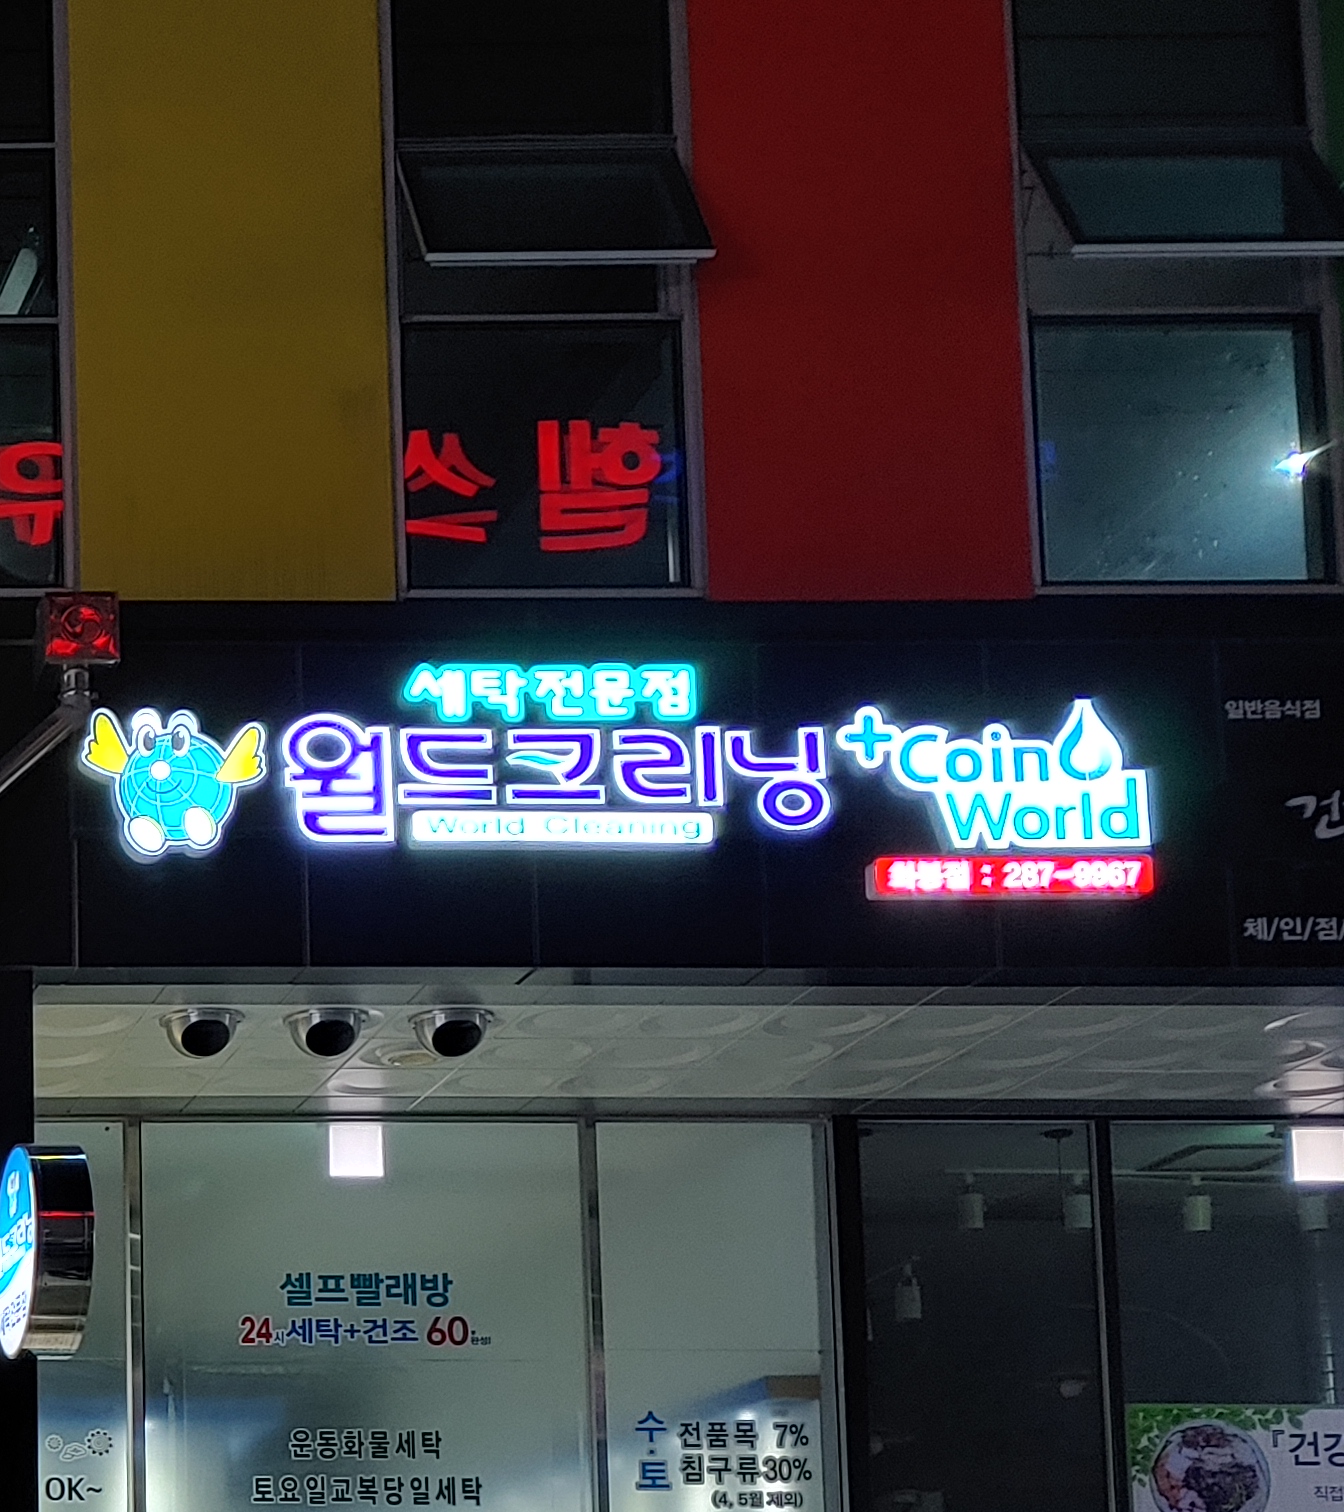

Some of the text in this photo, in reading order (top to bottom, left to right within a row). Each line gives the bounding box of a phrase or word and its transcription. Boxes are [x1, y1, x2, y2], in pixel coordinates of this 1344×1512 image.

[408, 667, 692, 719] 세탁전문점
[1225, 699, 1320, 719] 일반음식점
[283, 712, 832, 843] 월드크리닝
[946, 778, 1139, 840] World
[428, 815, 701, 840] World Cleaning
[279, 1272, 453, 1307] 셀프빨래방
[678, 1421, 810, 1450] 전품목 7%
[680, 1454, 813, 1485] 침구류 30%
